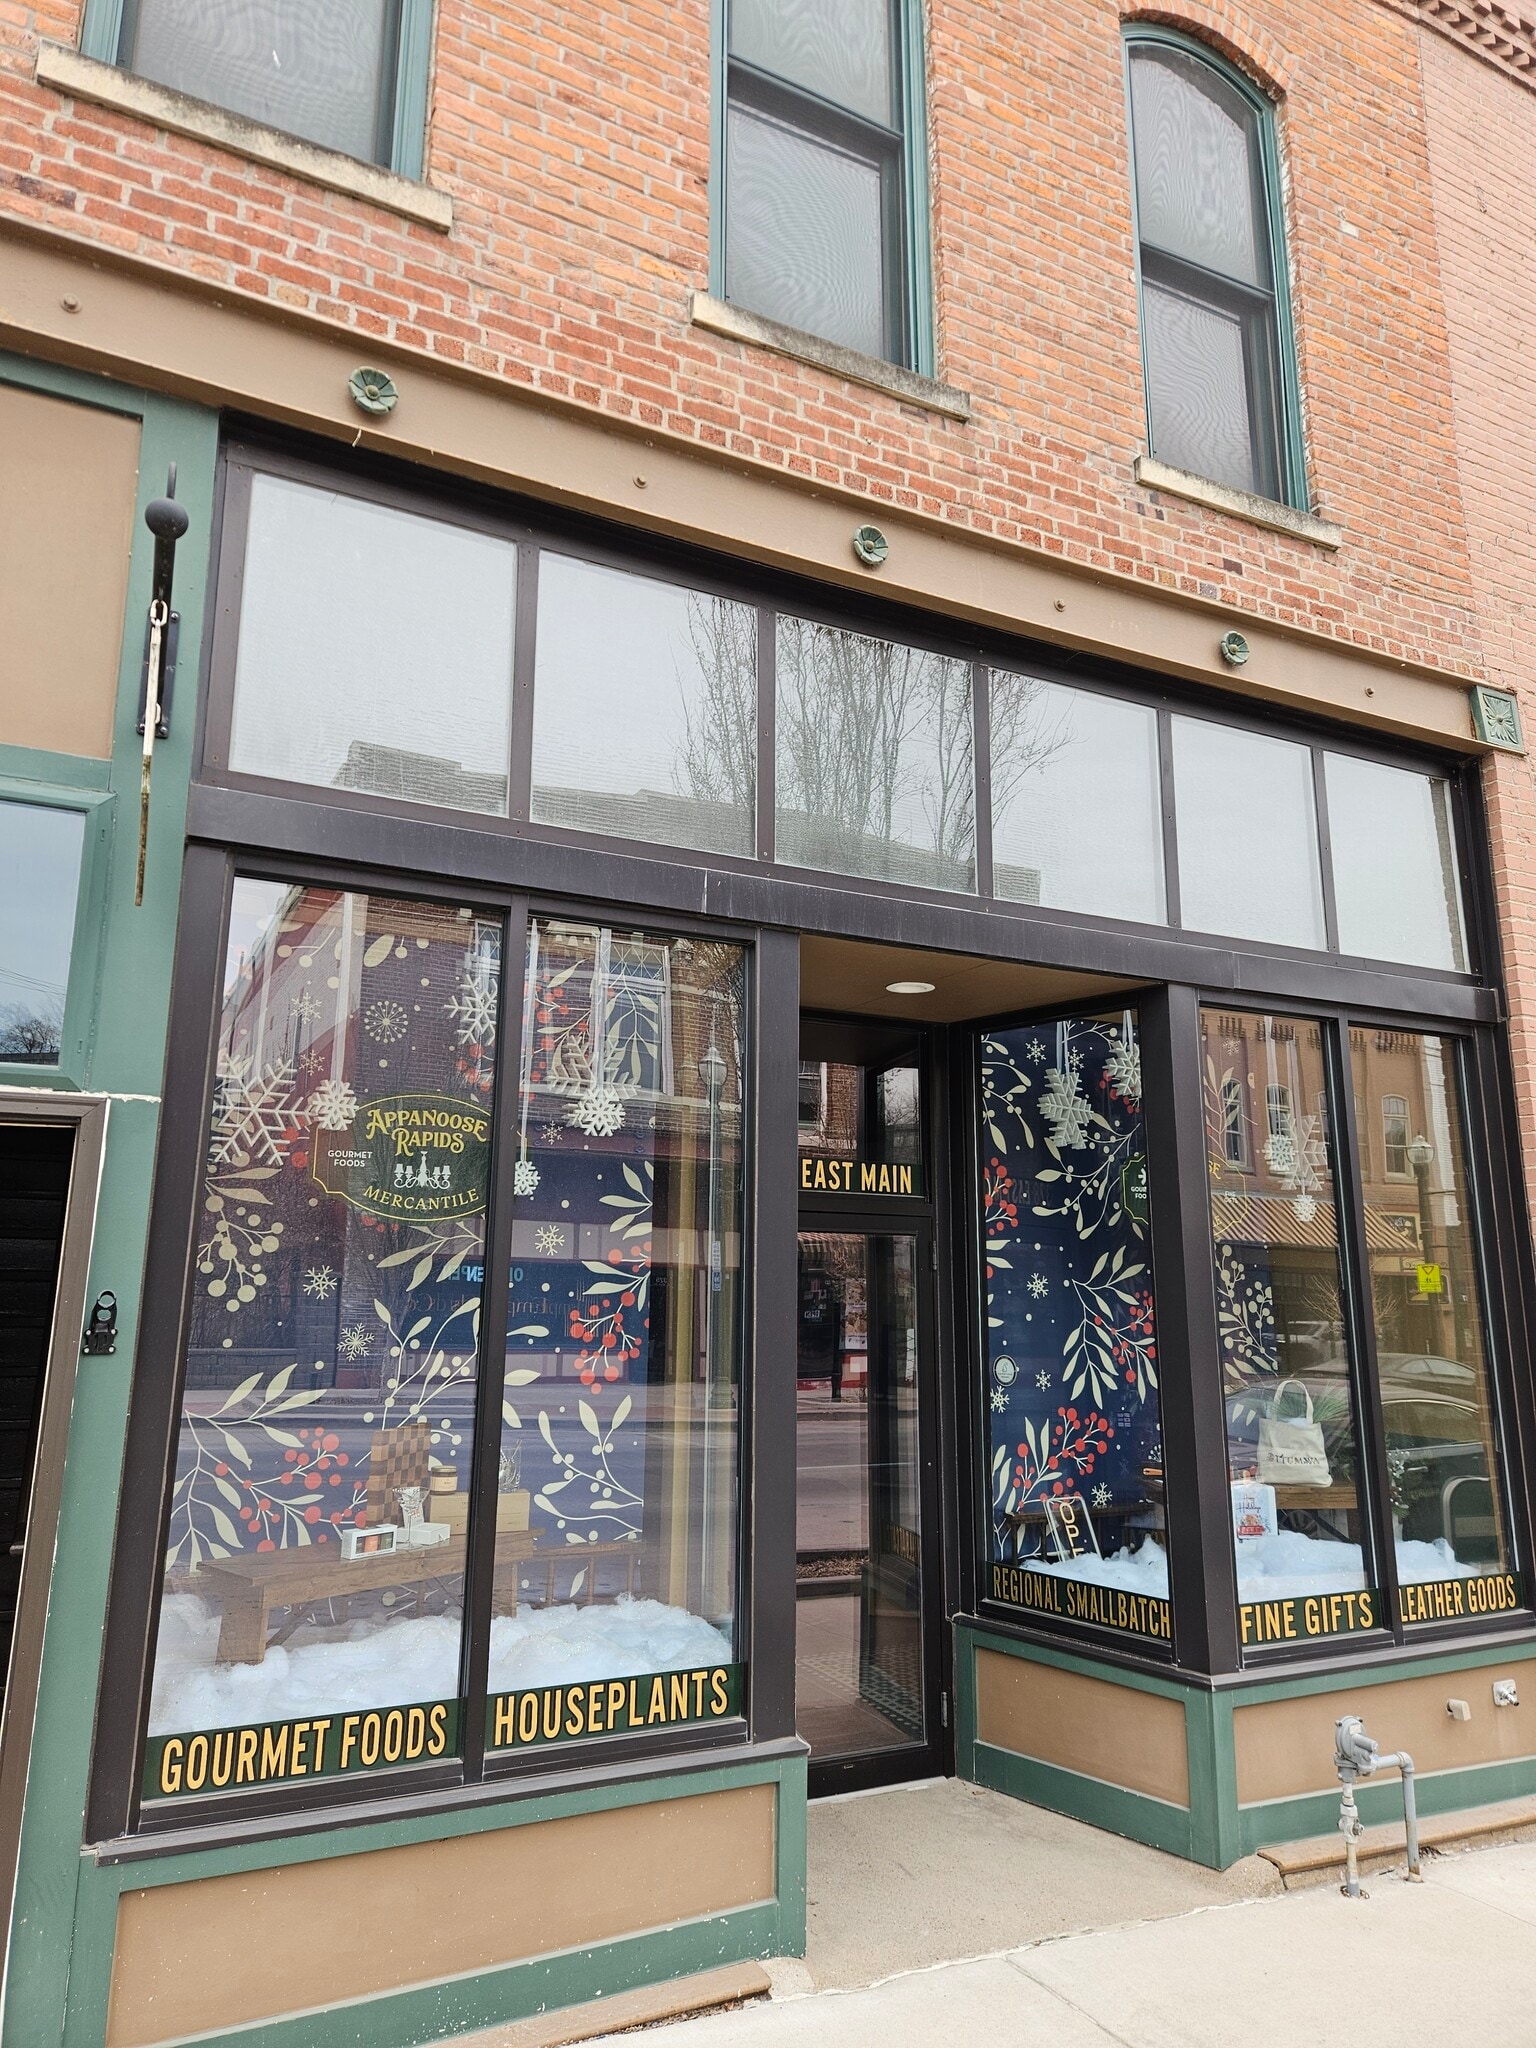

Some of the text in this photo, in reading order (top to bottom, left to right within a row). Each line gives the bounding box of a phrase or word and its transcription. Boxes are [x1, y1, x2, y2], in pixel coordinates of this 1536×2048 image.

[365, 1108, 488, 1143] APPANOOSE
[390, 1127, 465, 1157] RAPIDS
[327, 1149, 373, 1160] GOURMET
[333, 1158, 366, 1168] FOODS
[801, 1158, 912, 1194] EAST MAIN
[363, 1184, 480, 1211] MERCANTILE
[993, 1565, 1171, 1639] REGIONAL SMALLBATCH
[1398, 1574, 1516, 1622] LEATHER GOODS
[1240, 1592, 1374, 1644] FINE GIFTS
[494, 1668, 728, 1746] HOUSEPLANTS
[160, 1704, 447, 1794] GOURMET FOODS
